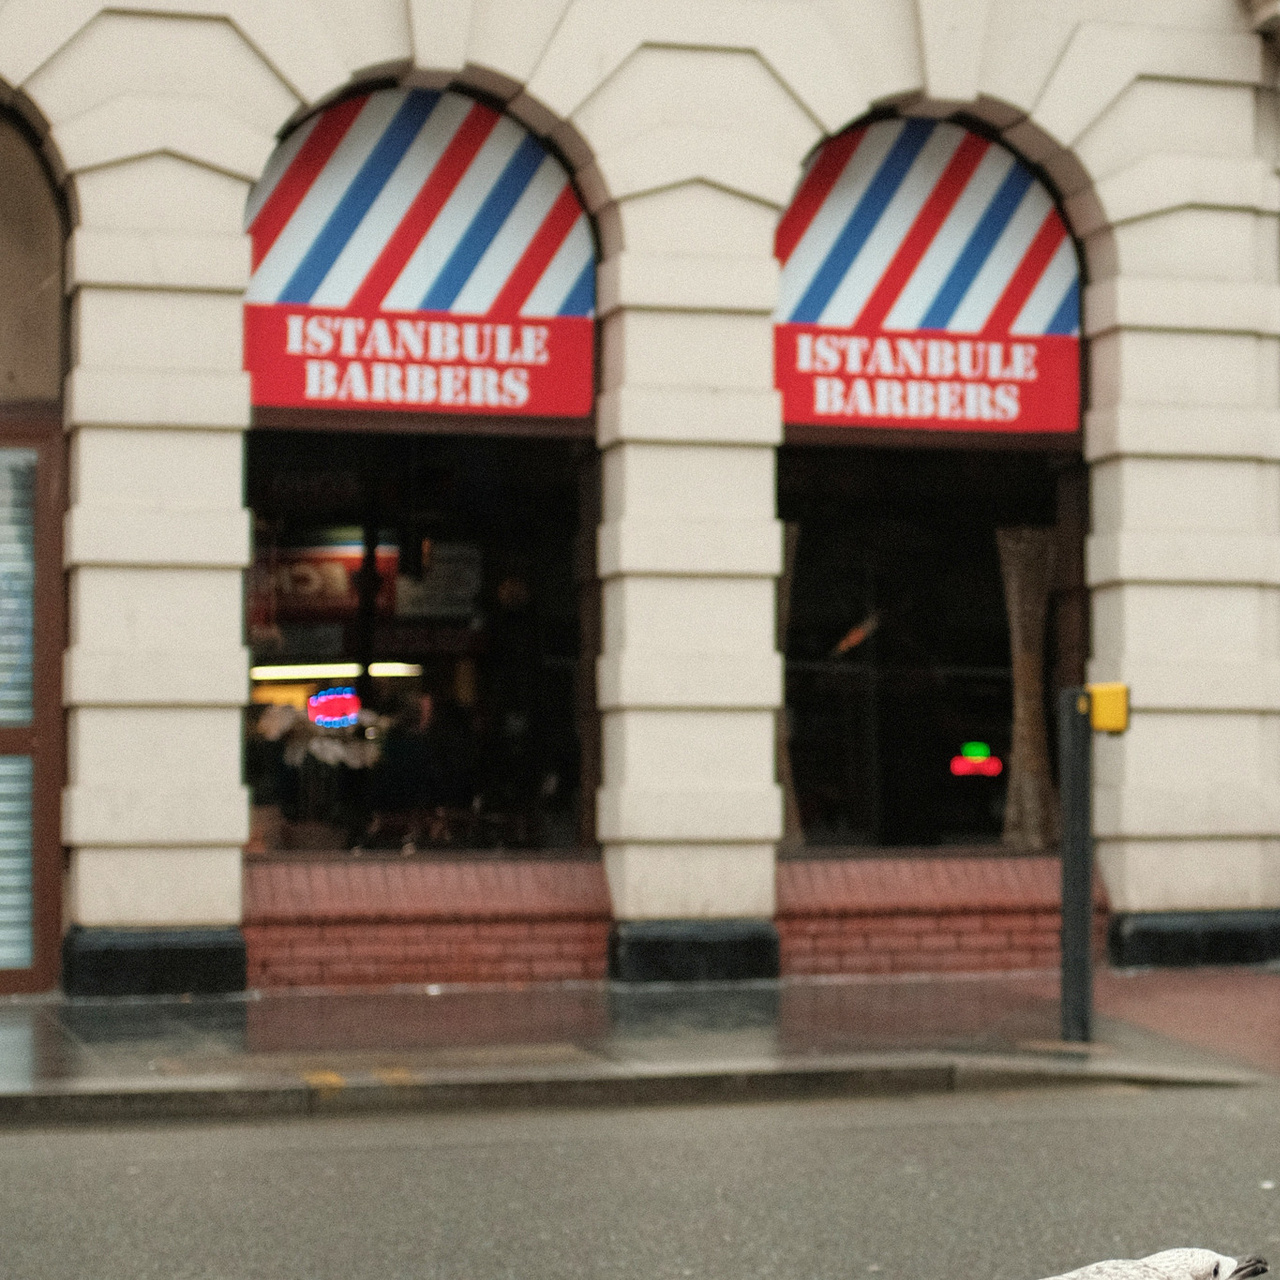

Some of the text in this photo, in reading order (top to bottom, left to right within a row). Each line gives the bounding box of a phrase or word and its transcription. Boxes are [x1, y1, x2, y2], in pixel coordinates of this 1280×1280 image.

[285, 314, 549, 365] ISTANBULE
[795, 333, 1039, 380] ISTANBULE
[305, 360, 530, 407] BARBERS
[814, 377, 1021, 421] BARBERS
